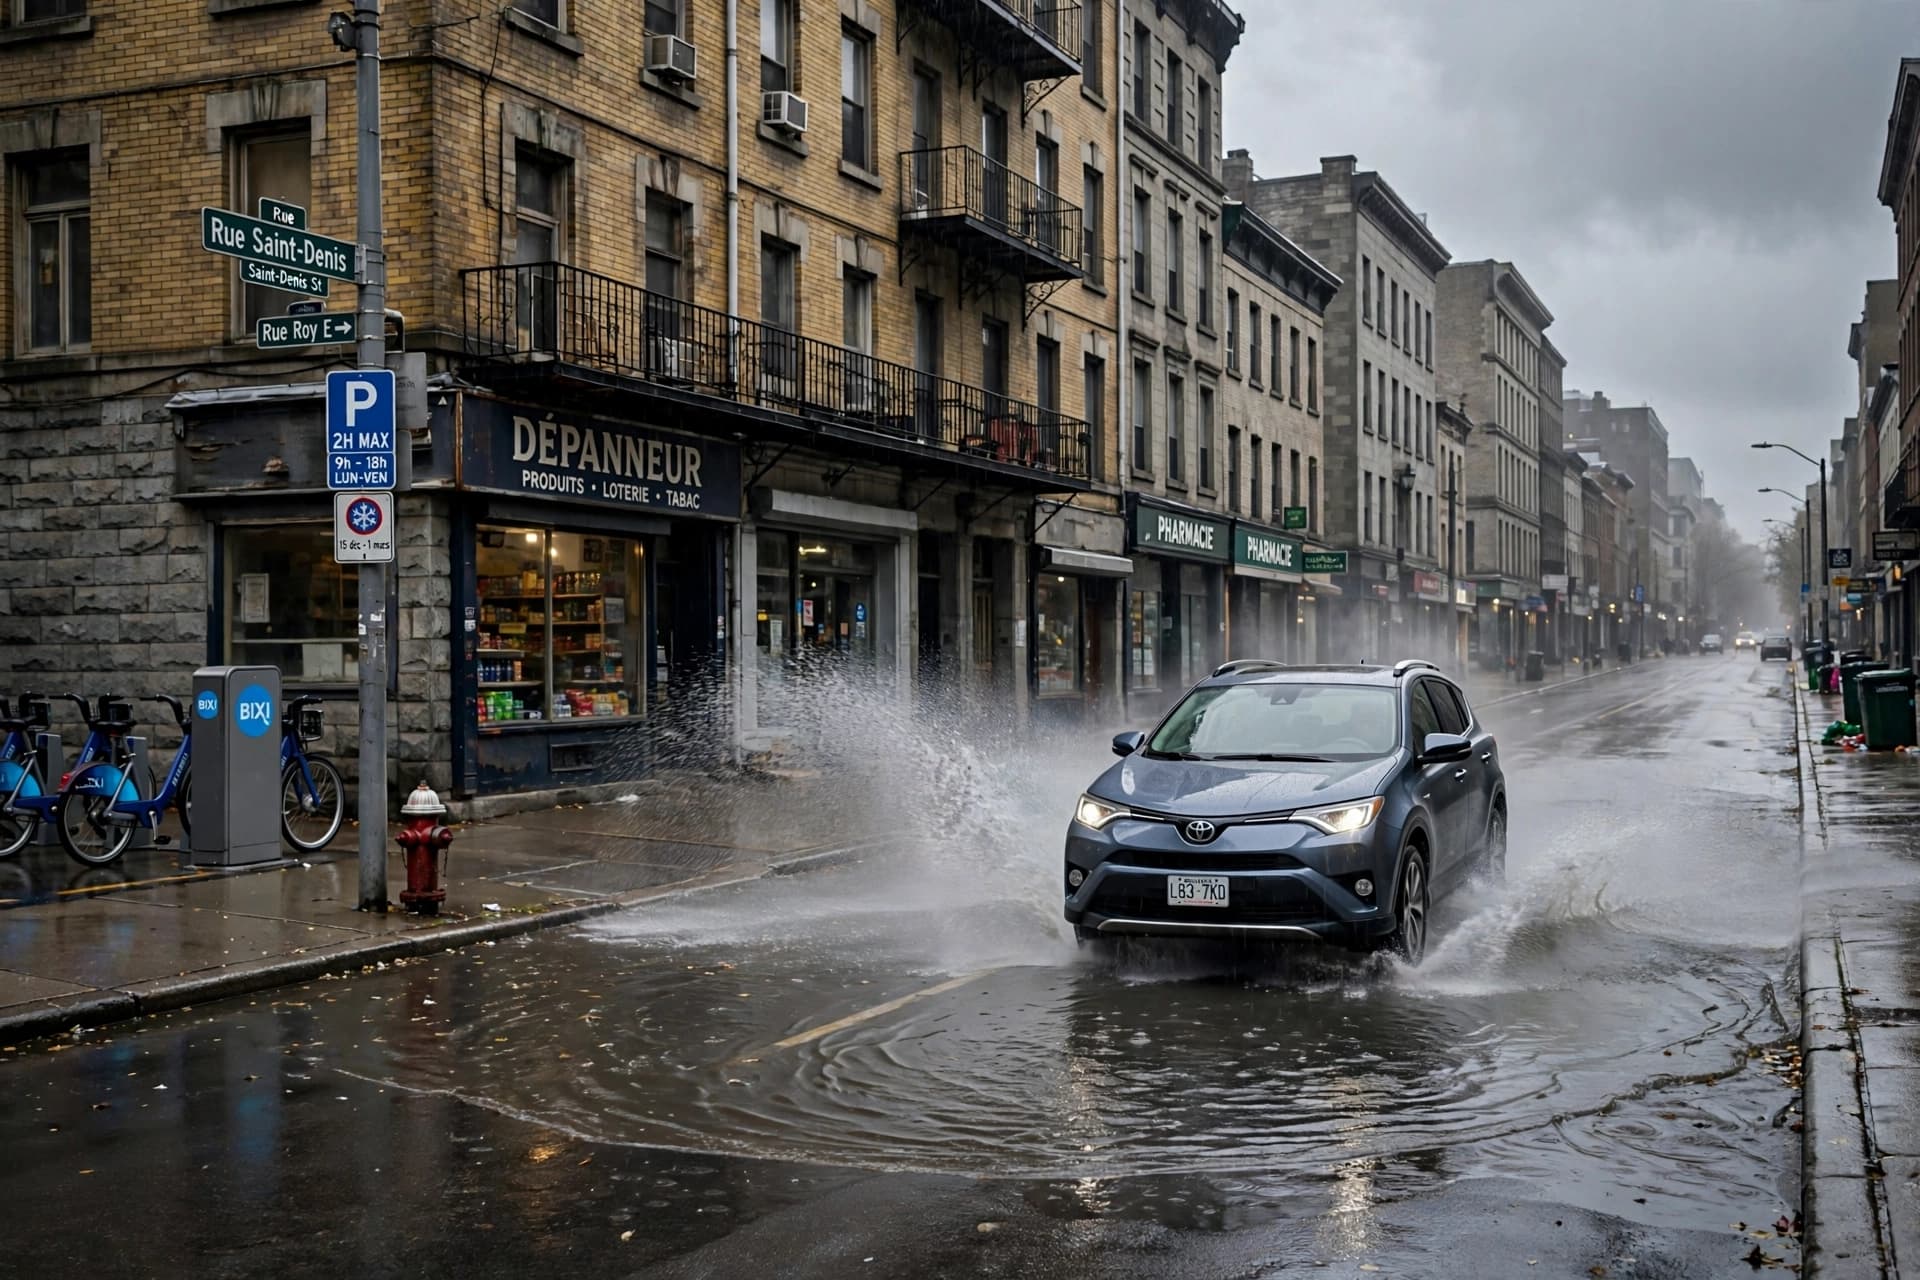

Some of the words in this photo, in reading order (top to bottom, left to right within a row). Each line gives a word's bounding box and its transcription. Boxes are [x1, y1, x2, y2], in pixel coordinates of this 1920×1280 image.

[273, 207, 295, 225] Rue
[211, 217, 245, 249] Rue
[252, 227, 347, 272] Saint-Denis
[248, 264, 308, 289] Saint-Denis
[311, 277, 322, 292] St
[262, 323, 288, 342] Rue
[293, 321, 318, 343] Roy
[323, 319, 333, 338] E
[346, 381, 378, 427] P
[333, 432, 353, 449] 2H
[359, 432, 389, 449] MAX
[512, 412, 702, 488] DÉPANNEUR
[335, 456, 351, 470] 9h
[366, 456, 387, 470] 18h
[335, 471, 388, 484] LUN-VEN
[522, 469, 585, 495] PRODUITS
[603, 480, 650, 503] LOTERIE
[666, 490, 701, 510] TABAC
[1158, 514, 1214, 550] PHARMACIE
[1247, 535, 1293, 567] PHARMACIE
[198, 699, 217, 711] BIXI
[240, 702, 270, 726] BIXI
